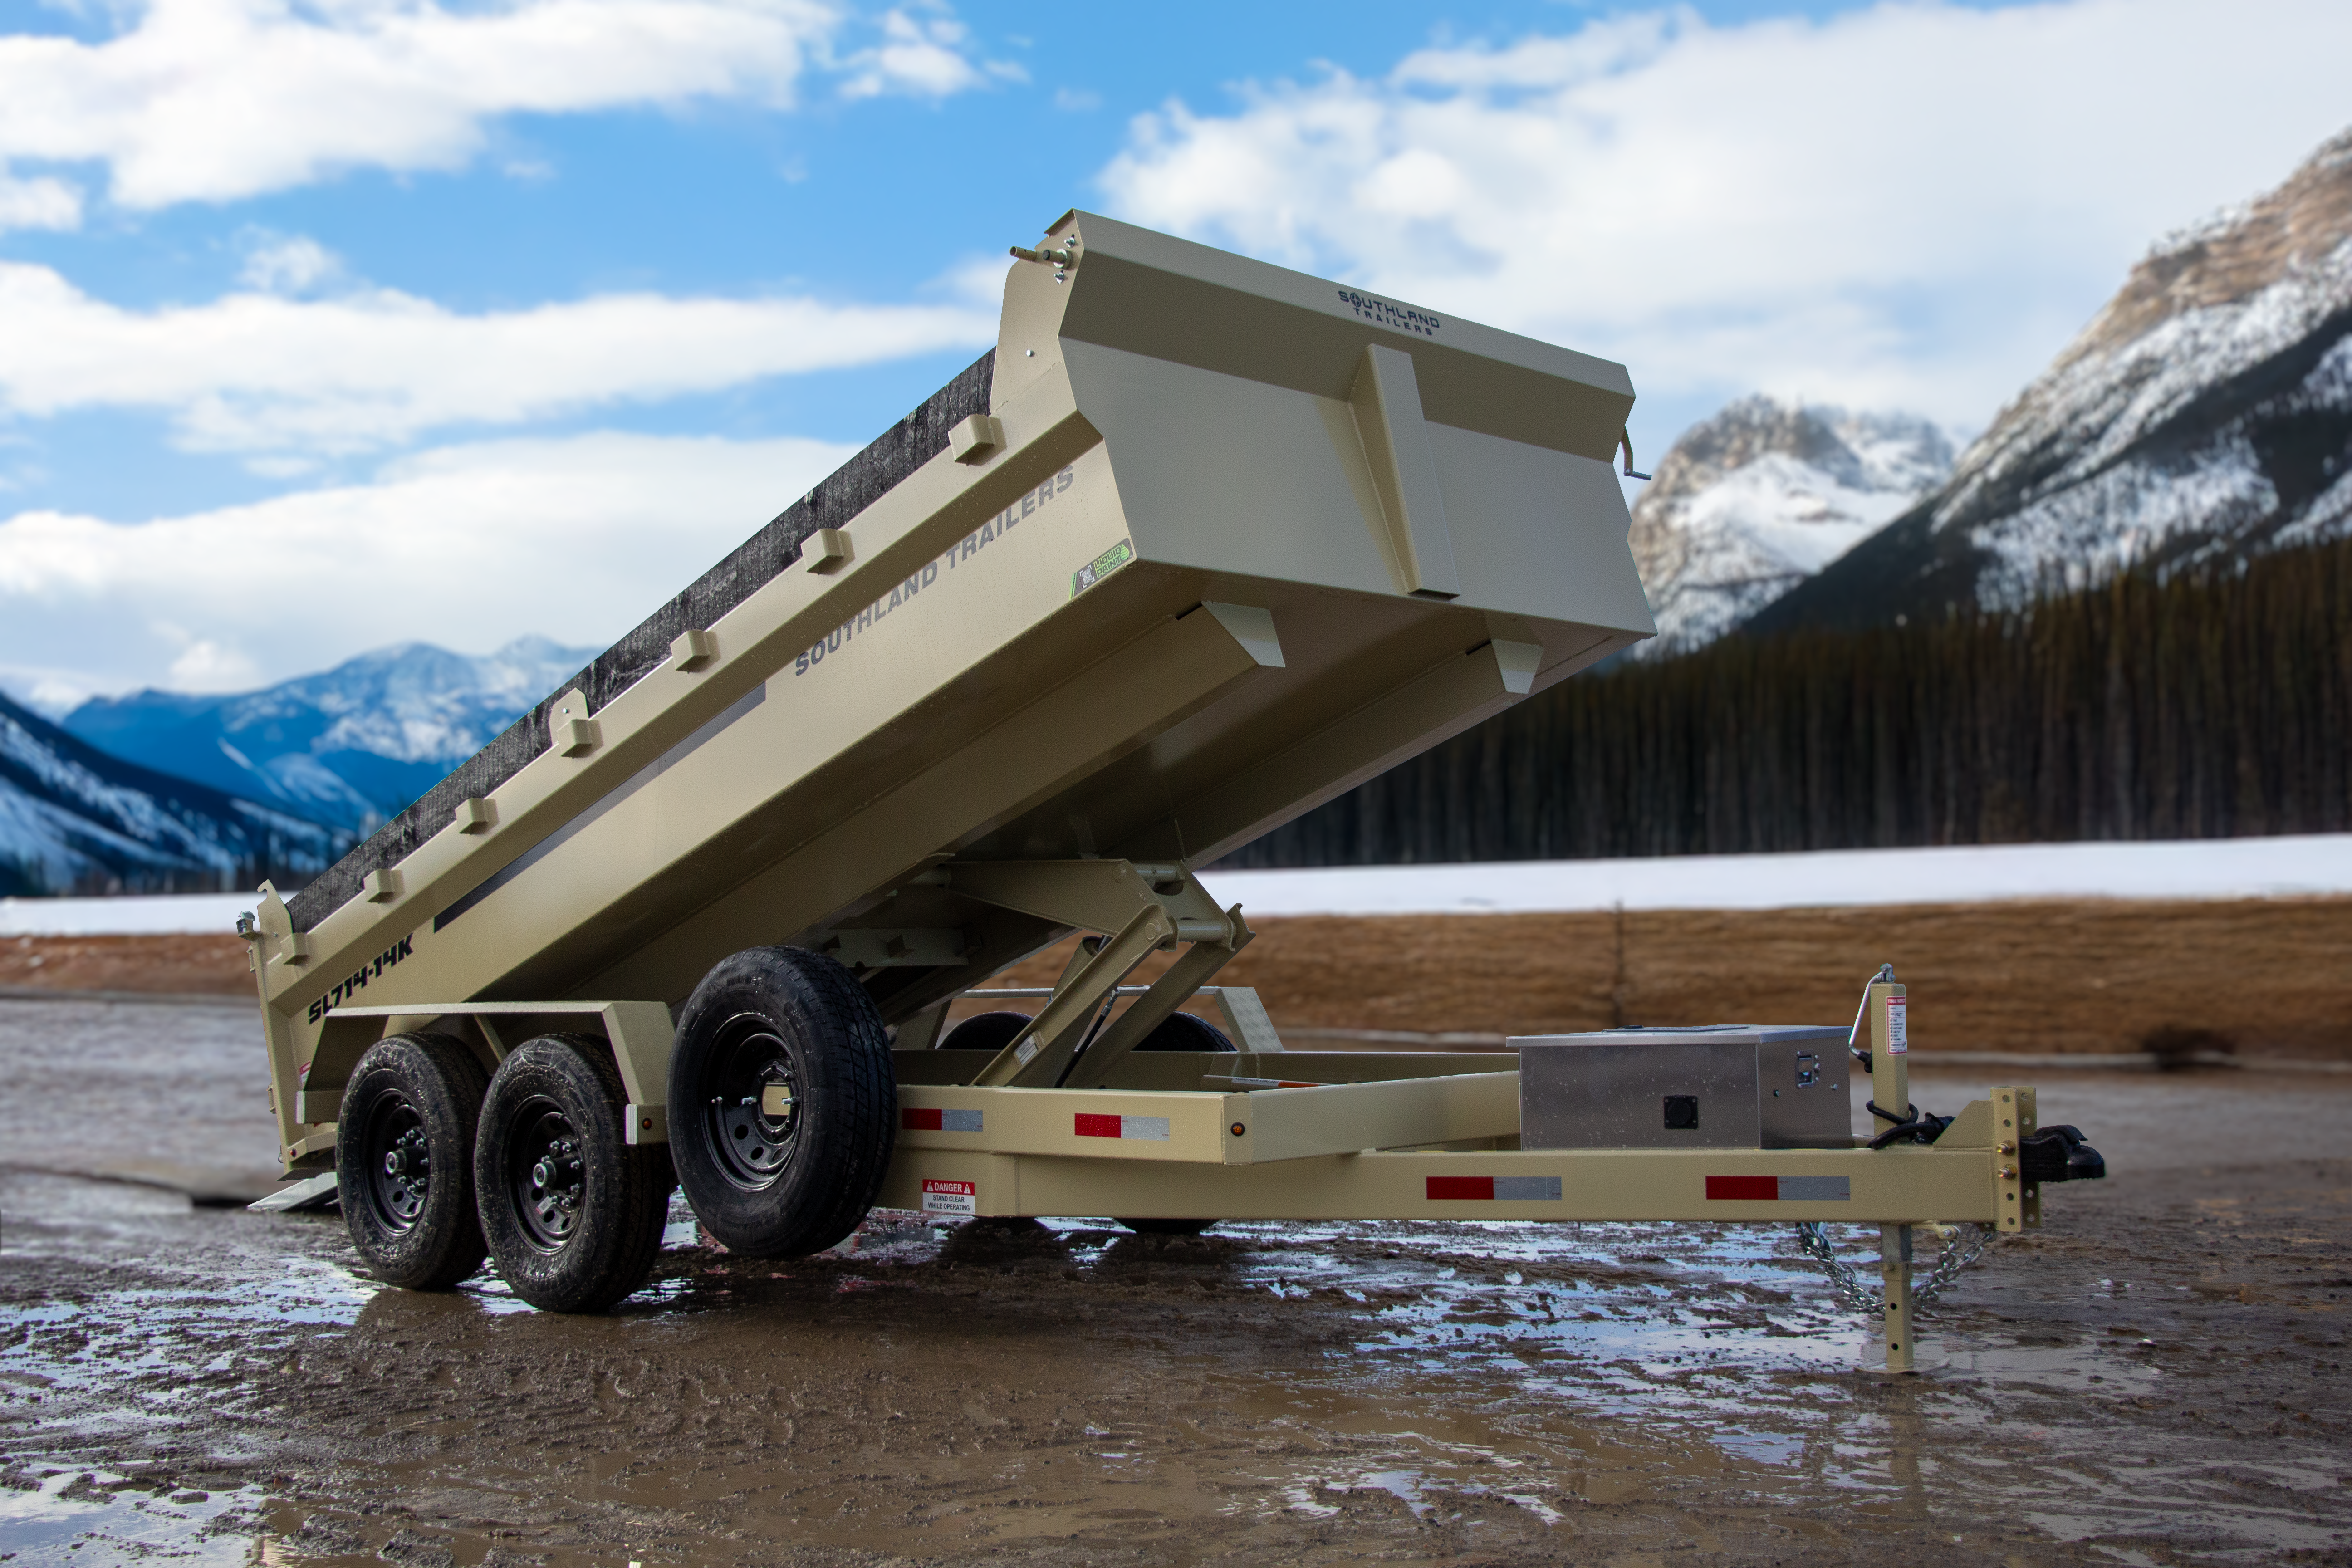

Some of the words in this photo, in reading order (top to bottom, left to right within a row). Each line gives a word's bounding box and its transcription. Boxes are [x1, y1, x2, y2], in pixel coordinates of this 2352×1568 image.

[1338, 290, 1440, 328] SOUTHLAND
[1353, 307, 1432, 336] TRAILERS
[795, 560, 938, 676] SOUTHLAND
[946, 465, 1074, 570] TRAILERS
[1093, 545, 1122, 569] LIQUID
[1096, 554, 1122, 579] PAINT
[309, 932, 413, 1025] SL714-14K
[934, 1182, 963, 1193] DANGER
